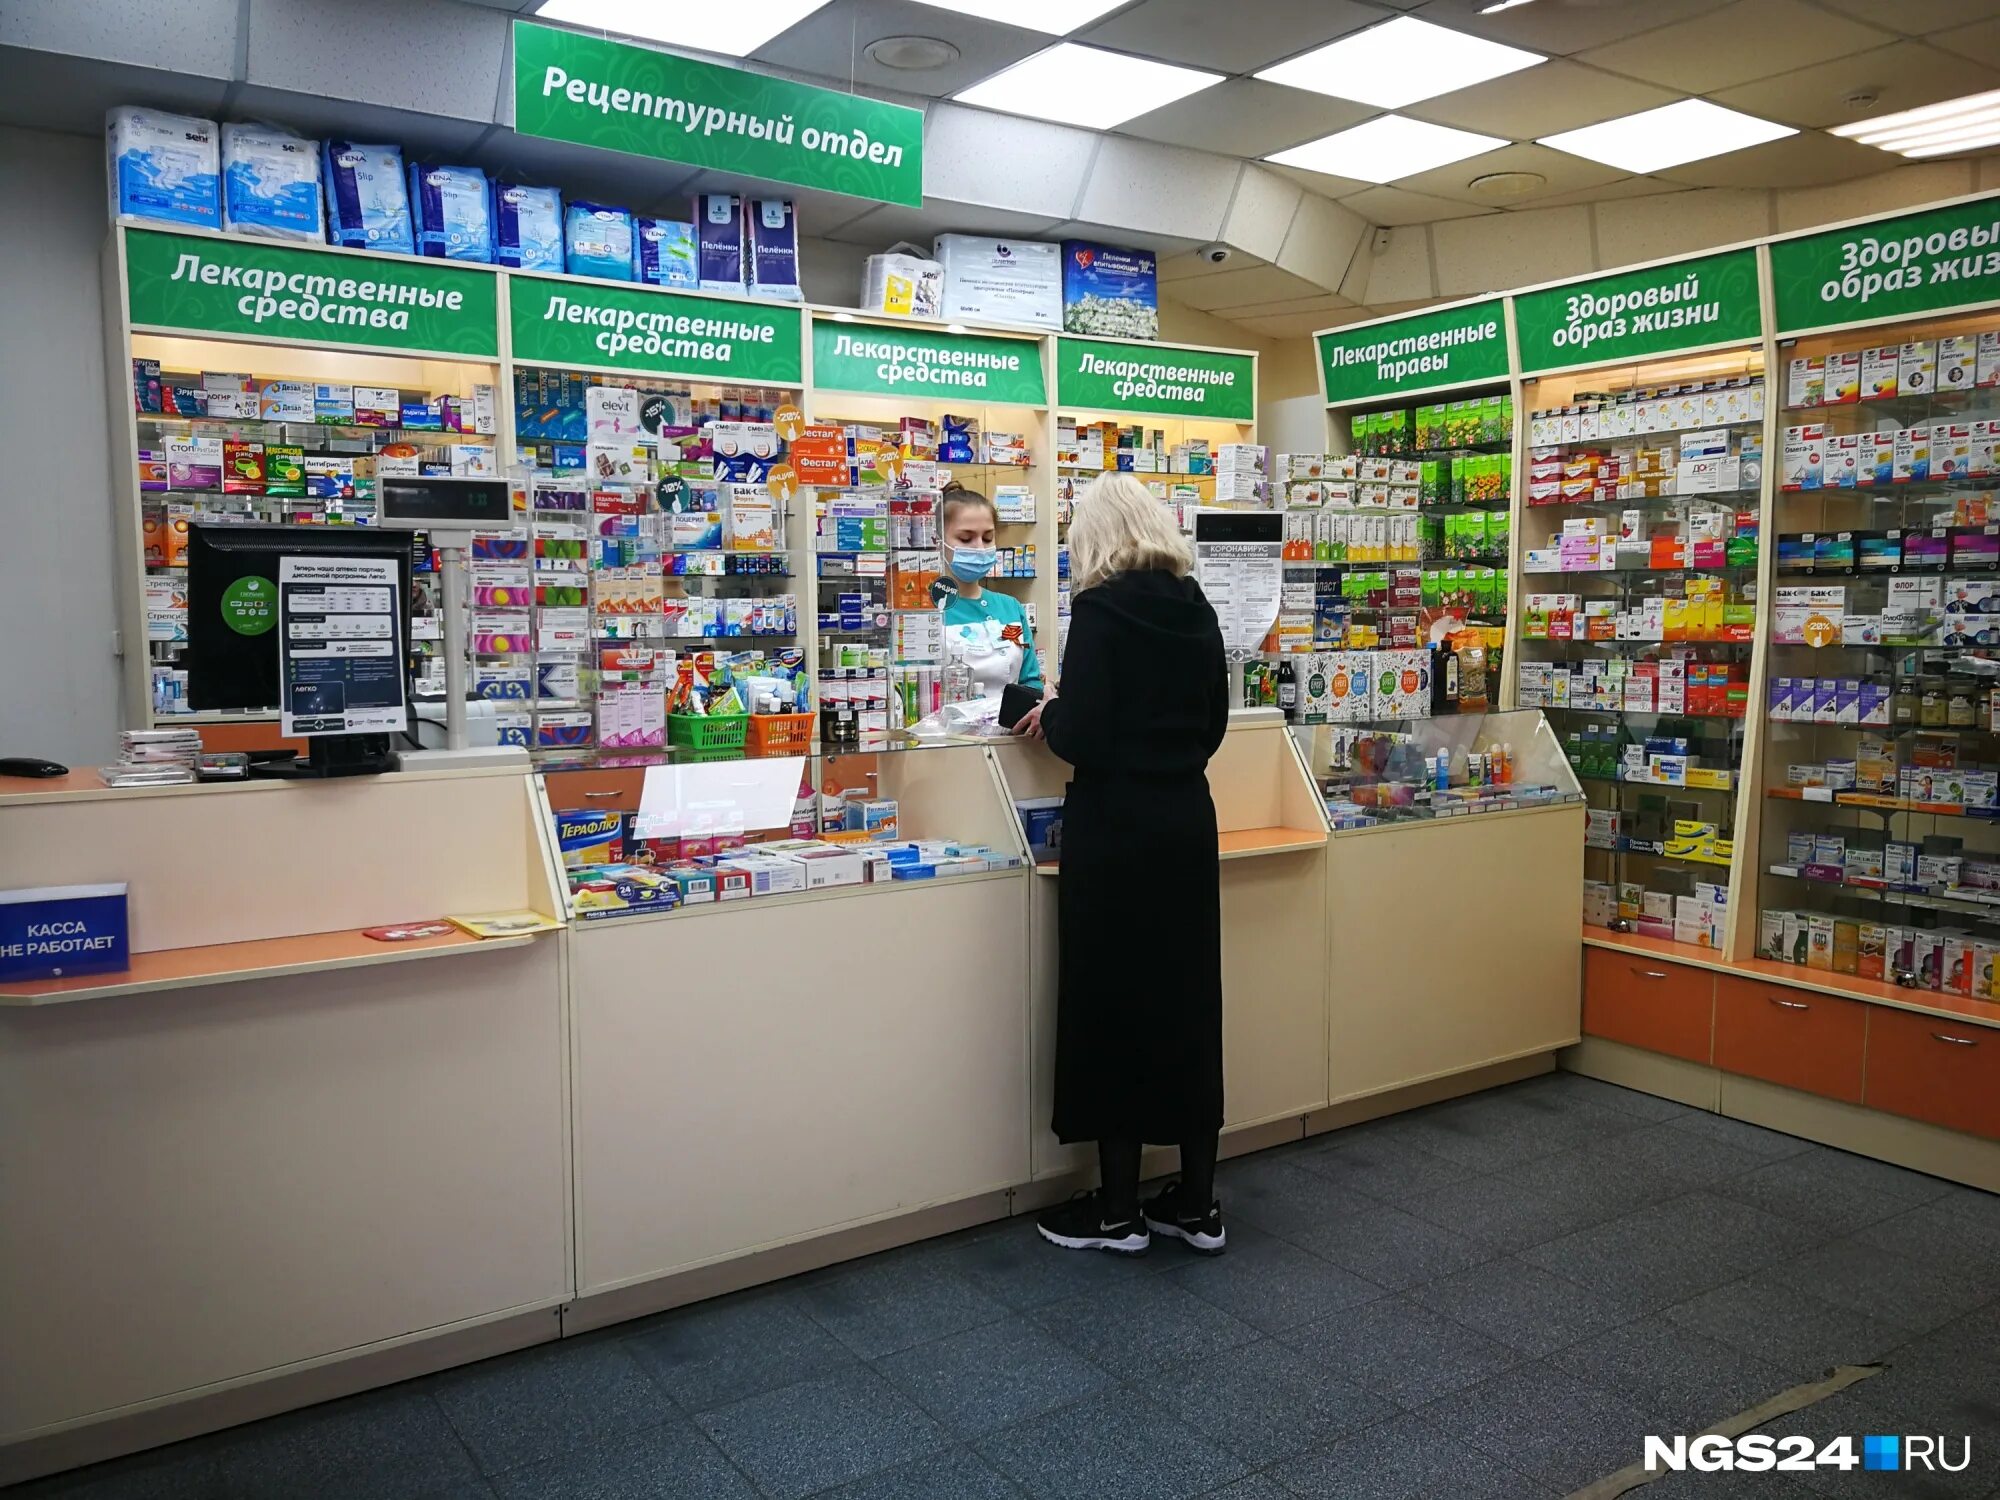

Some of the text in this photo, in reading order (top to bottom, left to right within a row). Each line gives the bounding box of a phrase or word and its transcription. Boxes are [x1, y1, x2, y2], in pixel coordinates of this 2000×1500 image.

[542, 66, 903, 168] Рецептурный отдел
[338, 154, 367, 163] TENA
[357, 172, 374, 182] Slip
[428, 173, 453, 183] TENA
[443, 190, 458, 199] Slip
[504, 191, 529, 200] TENA
[701, 241, 738, 252] Пелёнки
[757, 245, 794, 255] Пелёнки
[1839, 222, 2000, 274] Здоровы
[1102, 251, 1131, 262] Пеленки
[170, 254, 463, 312] Лекарственные
[1820, 268, 1922, 303] образ
[1565, 274, 1698, 323] Здоровый
[238, 291, 410, 331] средства
[543, 296, 775, 344] Лекарственные
[1552, 300, 1720, 349] образ жизни
[595, 329, 732, 362] средства
[1331, 320, 1497, 370] Лекарственные
[833, 335, 1020, 372] Лекарственные
[1940, 352, 1965, 361] Биотин
[1377, 350, 1449, 382] травы
[1900, 357, 1925, 366] Биотин
[877, 360, 988, 389] средства
[1078, 353, 1235, 387] Лекарственные
[1112, 377, 1205, 402] средства
[601, 400, 631, 411] elevit
[645, 400, 666, 418] -15%
[777, 410, 801, 422] -20%
[800, 457, 836, 468] Фестал
[769, 470, 795, 483] АКЦИЯ
[660, 480, 684, 493] -10%
[733, 487, 759, 496] Бак-С
[1210, 545, 1269, 553] КОРОНАВИРУС
[293, 564, 316, 572] Теперь
[934, 581, 958, 596] АКЦИЯ
[560, 820, 618, 839] ТЕРАФЛЮ
[619, 885, 632, 894] 24
[28, 921, 86, 938] КАССА
[0, 936, 114, 958] НЕ РАБОТАЕТ
